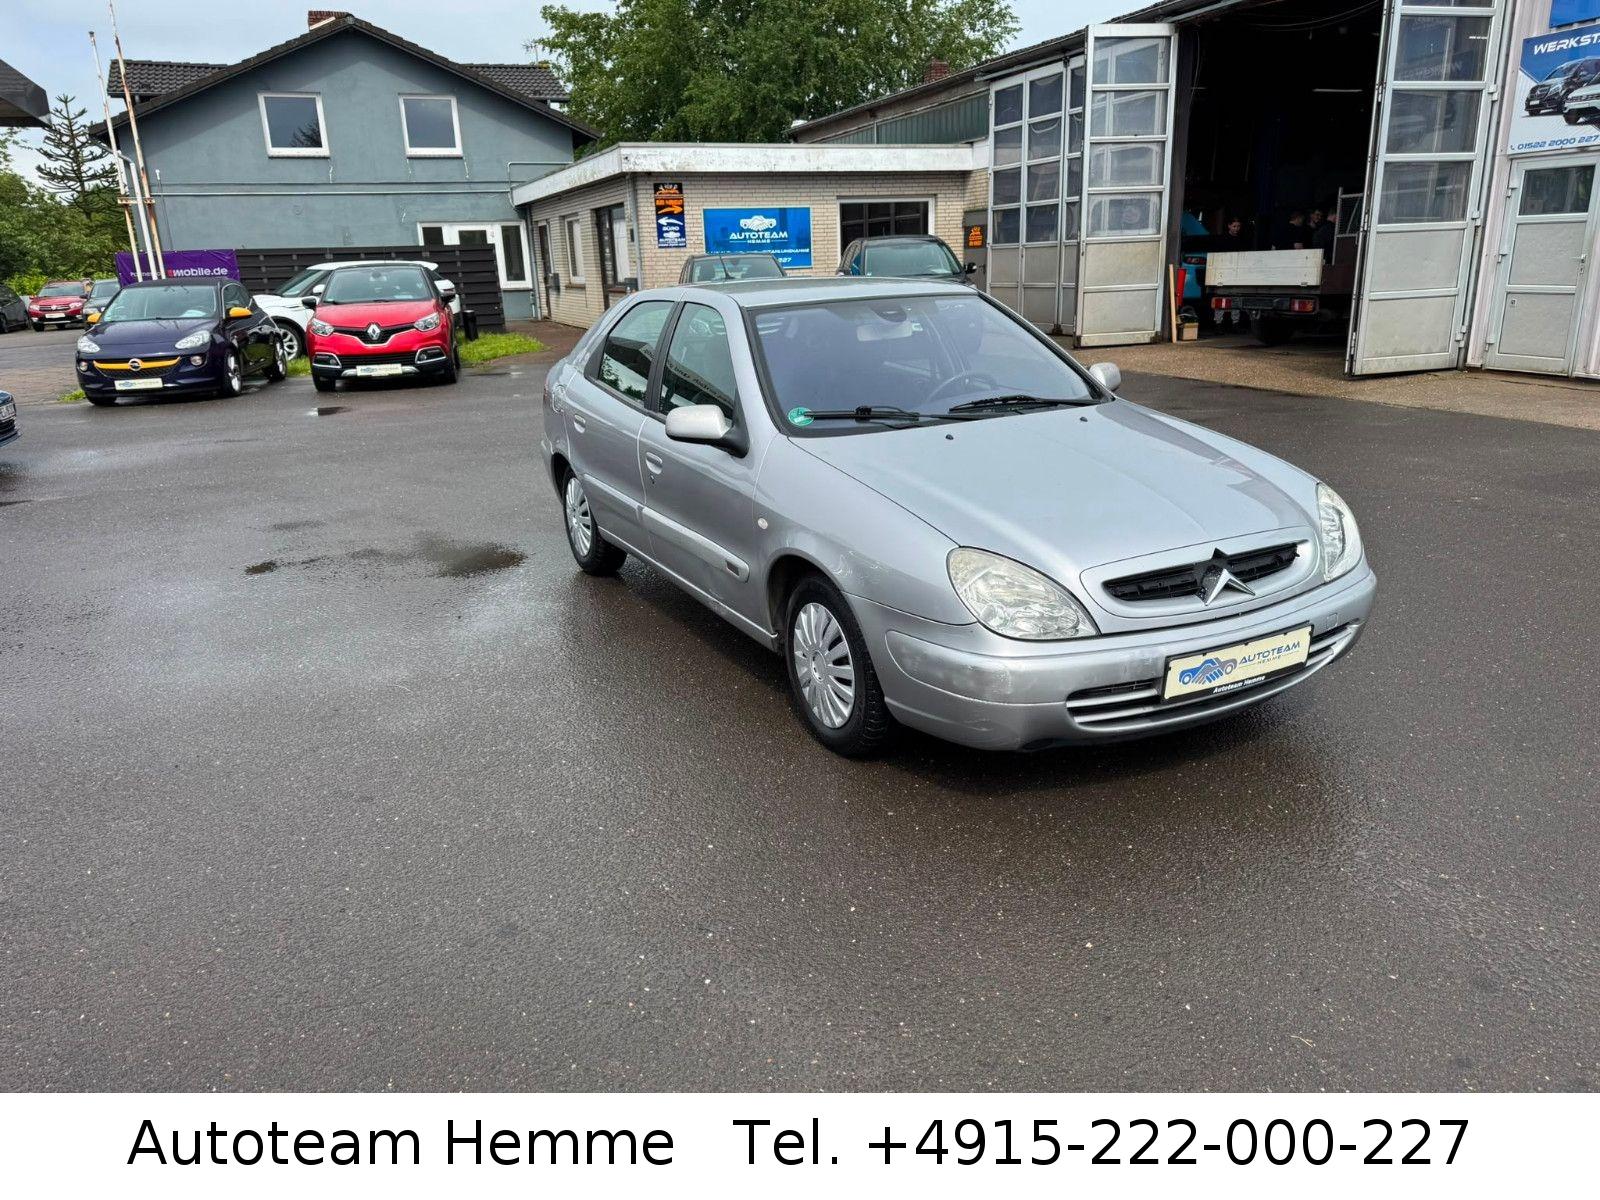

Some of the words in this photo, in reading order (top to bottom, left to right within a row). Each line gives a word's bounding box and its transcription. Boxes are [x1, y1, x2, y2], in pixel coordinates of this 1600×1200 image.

[1517, 140, 1546, 150] 01522
[1548, 137, 1576, 147] 2000
[1578, 134, 1599, 144] 227
[729, 231, 788, 240] AUTOTEAM
[172, 267, 228, 277] mobile.de
[1239, 641, 1300, 664] AUTOTEAM
[1257, 655, 1281, 664] HEMME
[1213, 682, 1243, 693] Autoteam
[1244, 676, 1266, 686] Hemme
